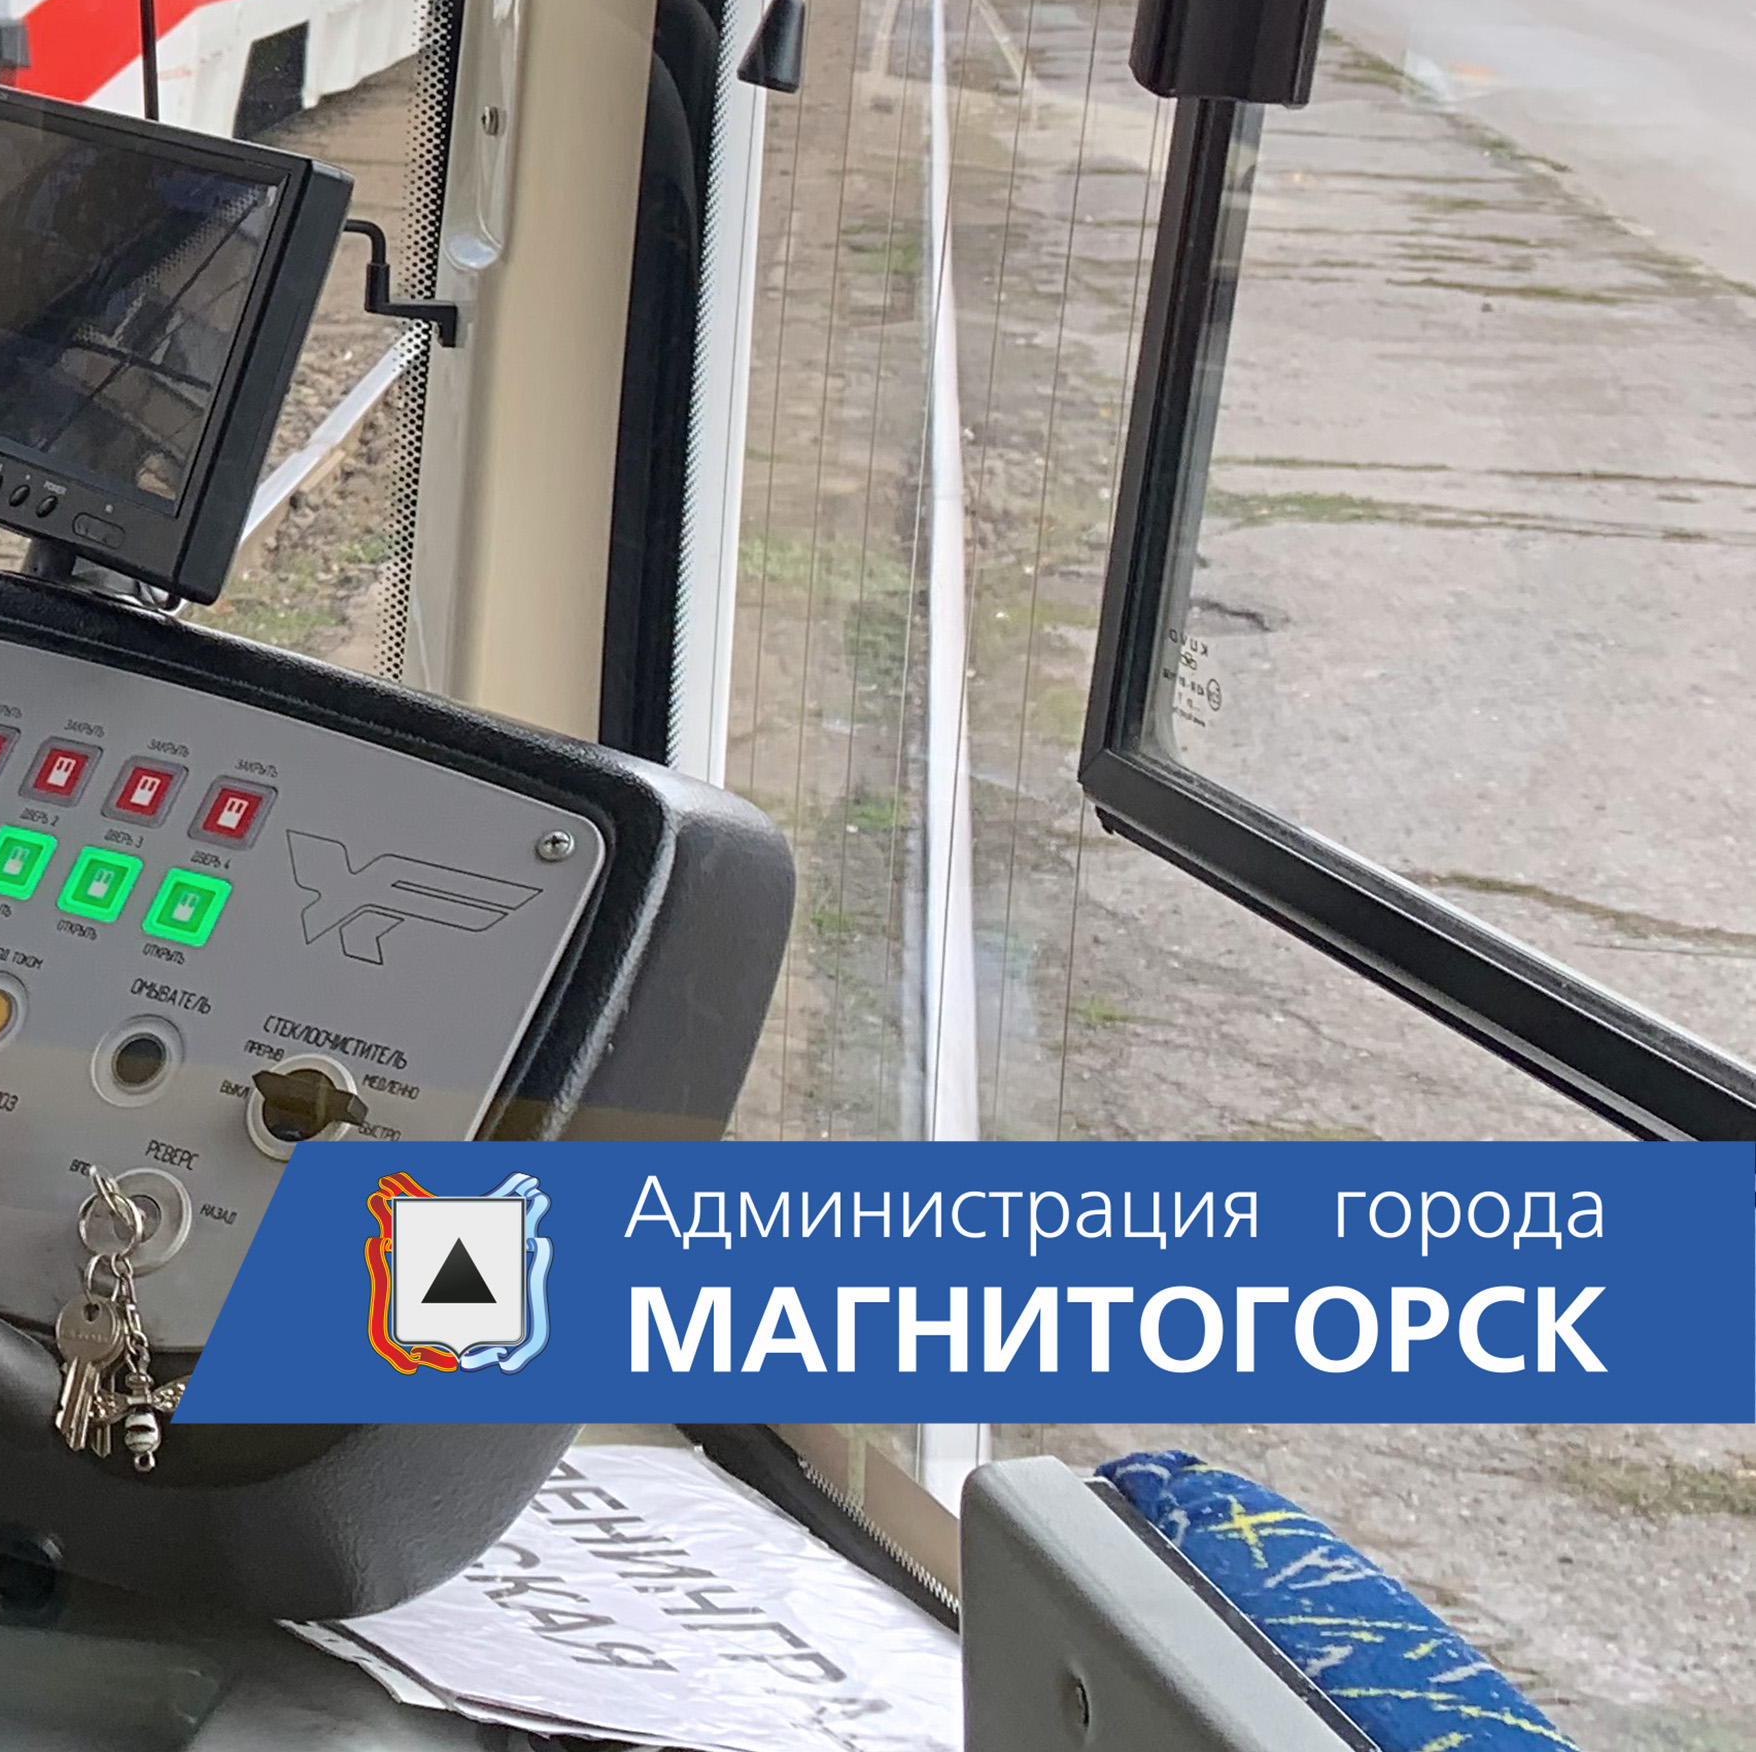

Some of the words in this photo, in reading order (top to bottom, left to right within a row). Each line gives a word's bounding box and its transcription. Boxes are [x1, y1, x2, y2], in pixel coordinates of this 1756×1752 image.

[130, 977, 212, 1016] ОМЫВАТЕЛЬ
[243, 1039, 285, 1063] ПРЕРЫВ
[263, 1014, 407, 1070] СТЕКЛООЧИСТИТЕЛЬ
[362, 1073, 420, 1100] МЕДЛЕННО
[69, 1159, 91, 1176] ВПЕ
[145, 1139, 199, 1170] РЕВЕРС
[199, 1203, 237, 1225] НАЗАД
